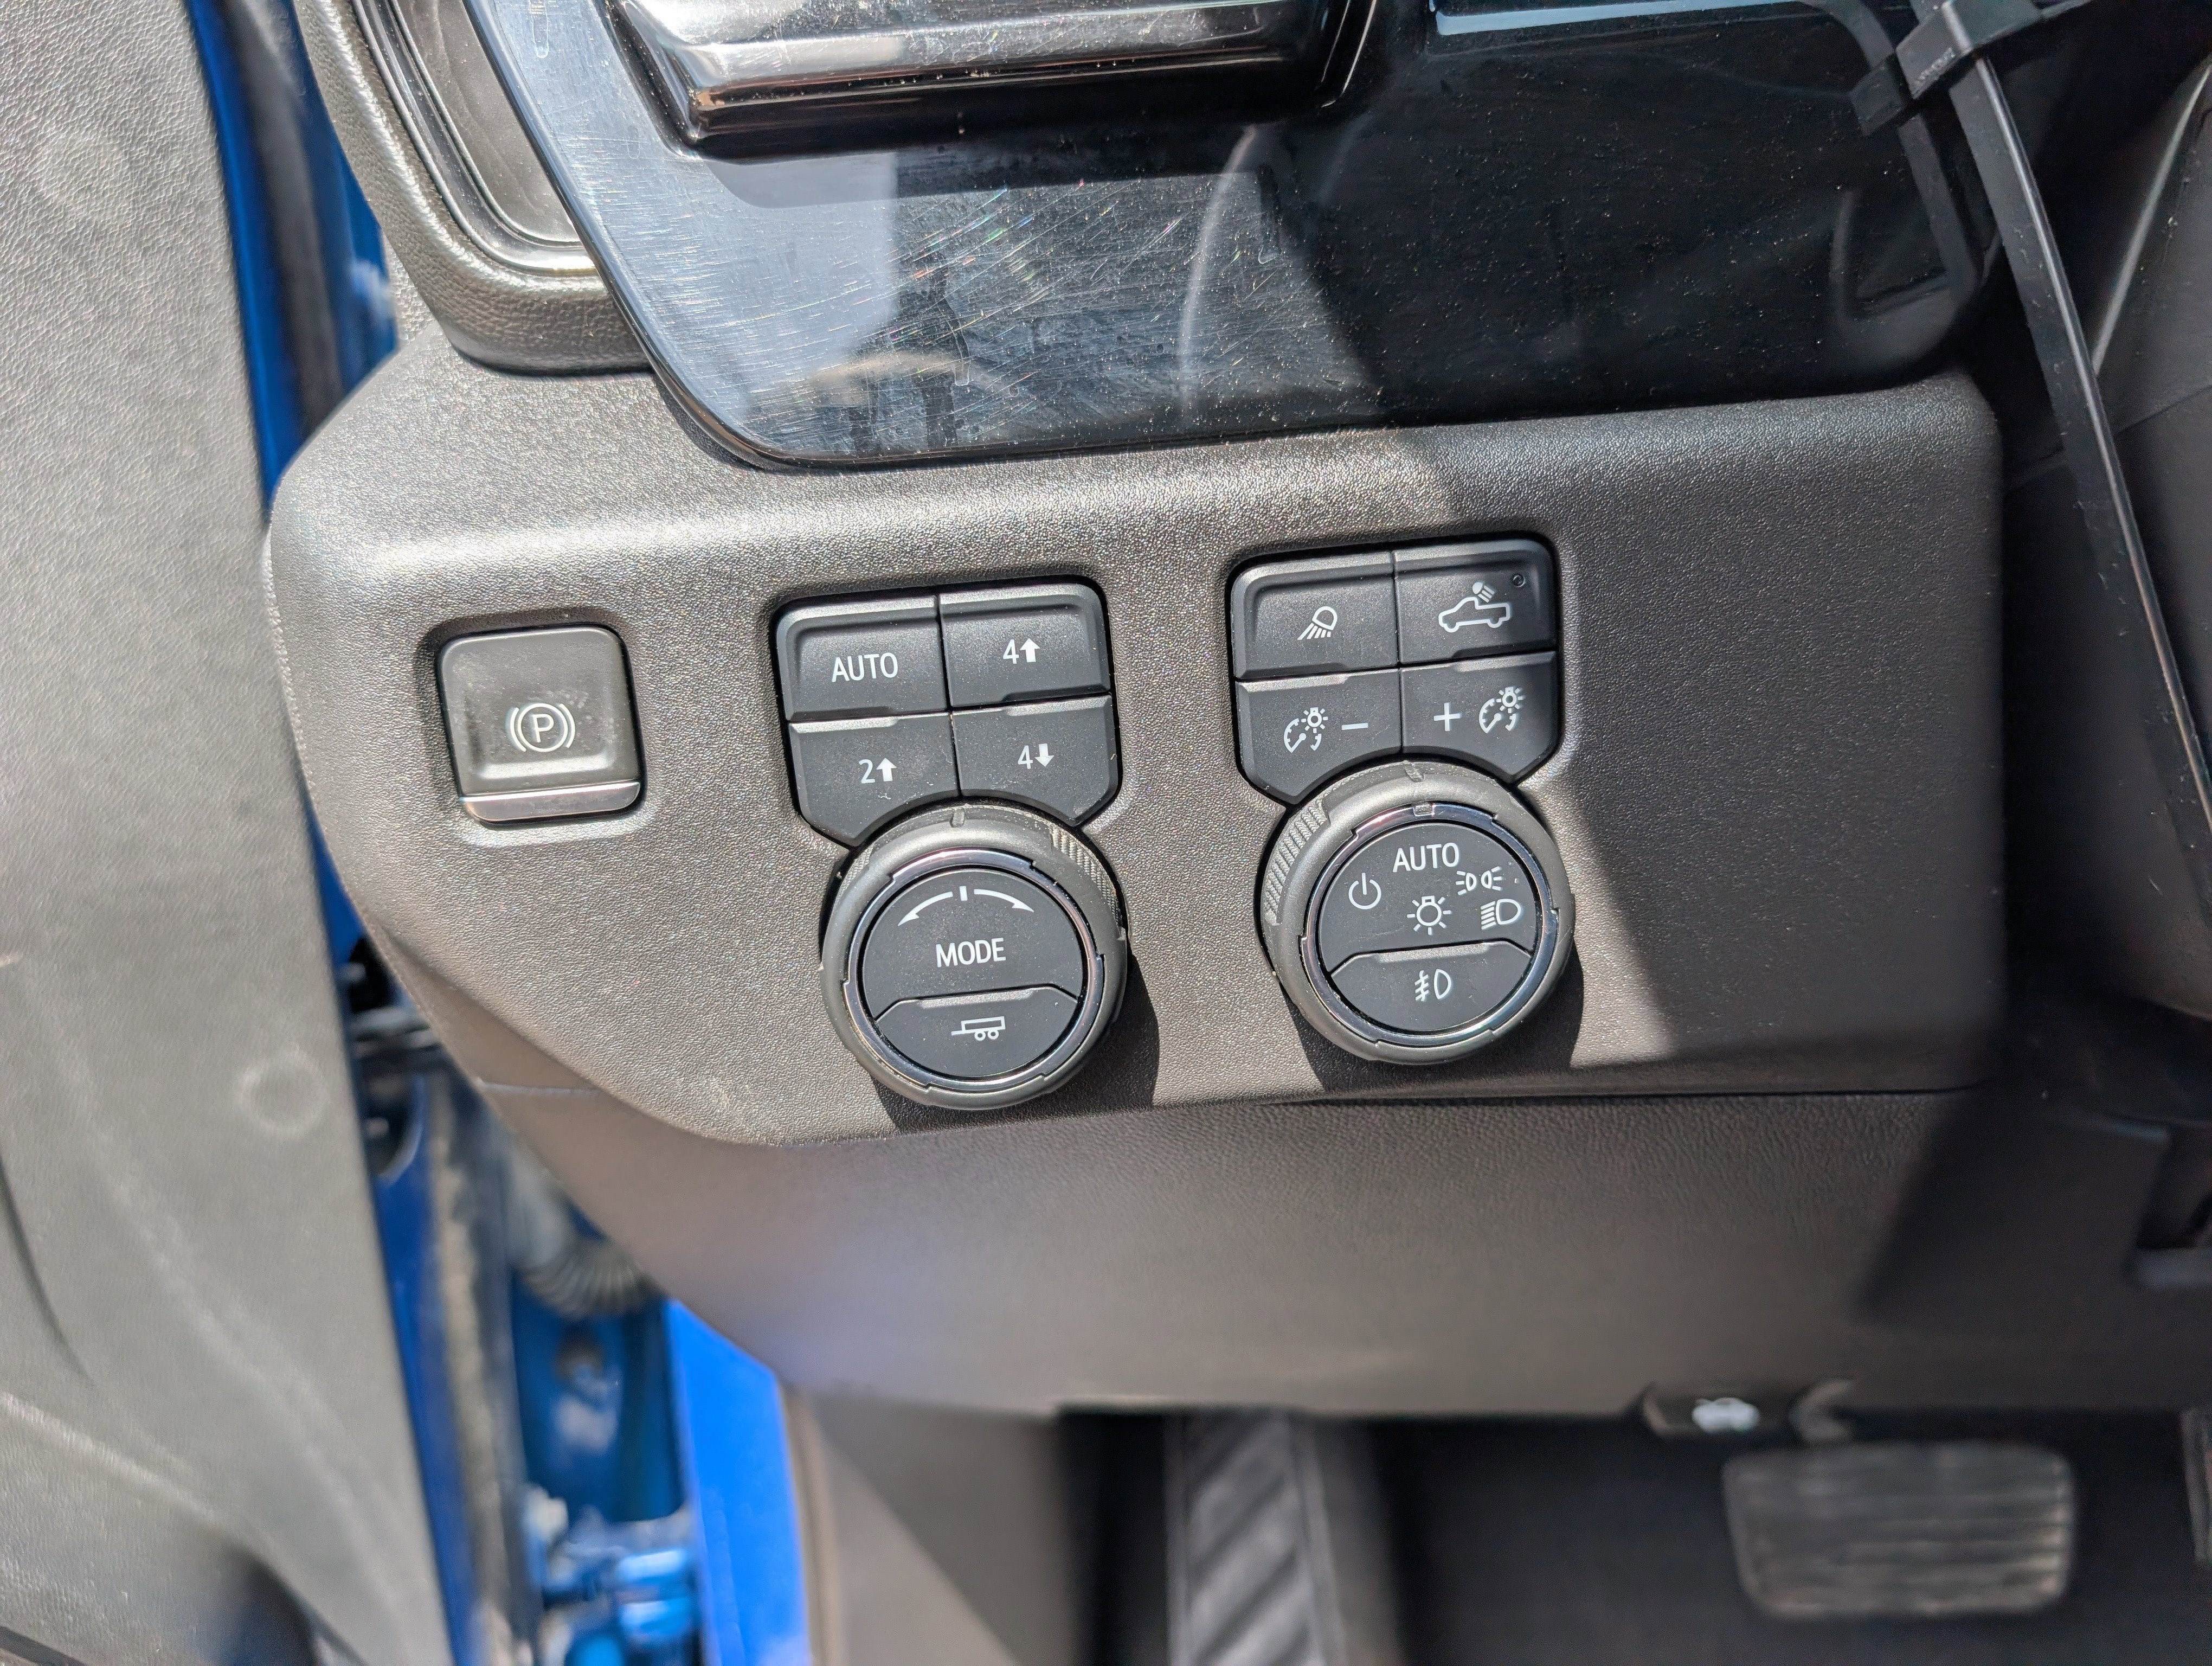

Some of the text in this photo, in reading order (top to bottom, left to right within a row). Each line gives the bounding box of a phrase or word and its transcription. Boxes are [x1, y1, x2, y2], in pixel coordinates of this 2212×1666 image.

[1002, 639, 1020, 665] 4
[832, 652, 899, 683] AUTO
[532, 714, 555, 743] P
[859, 759, 876, 785] 2
[1018, 745, 1033, 770] 4
[1392, 842, 1460, 873] AUTO
[936, 937, 1007, 968] MODE
